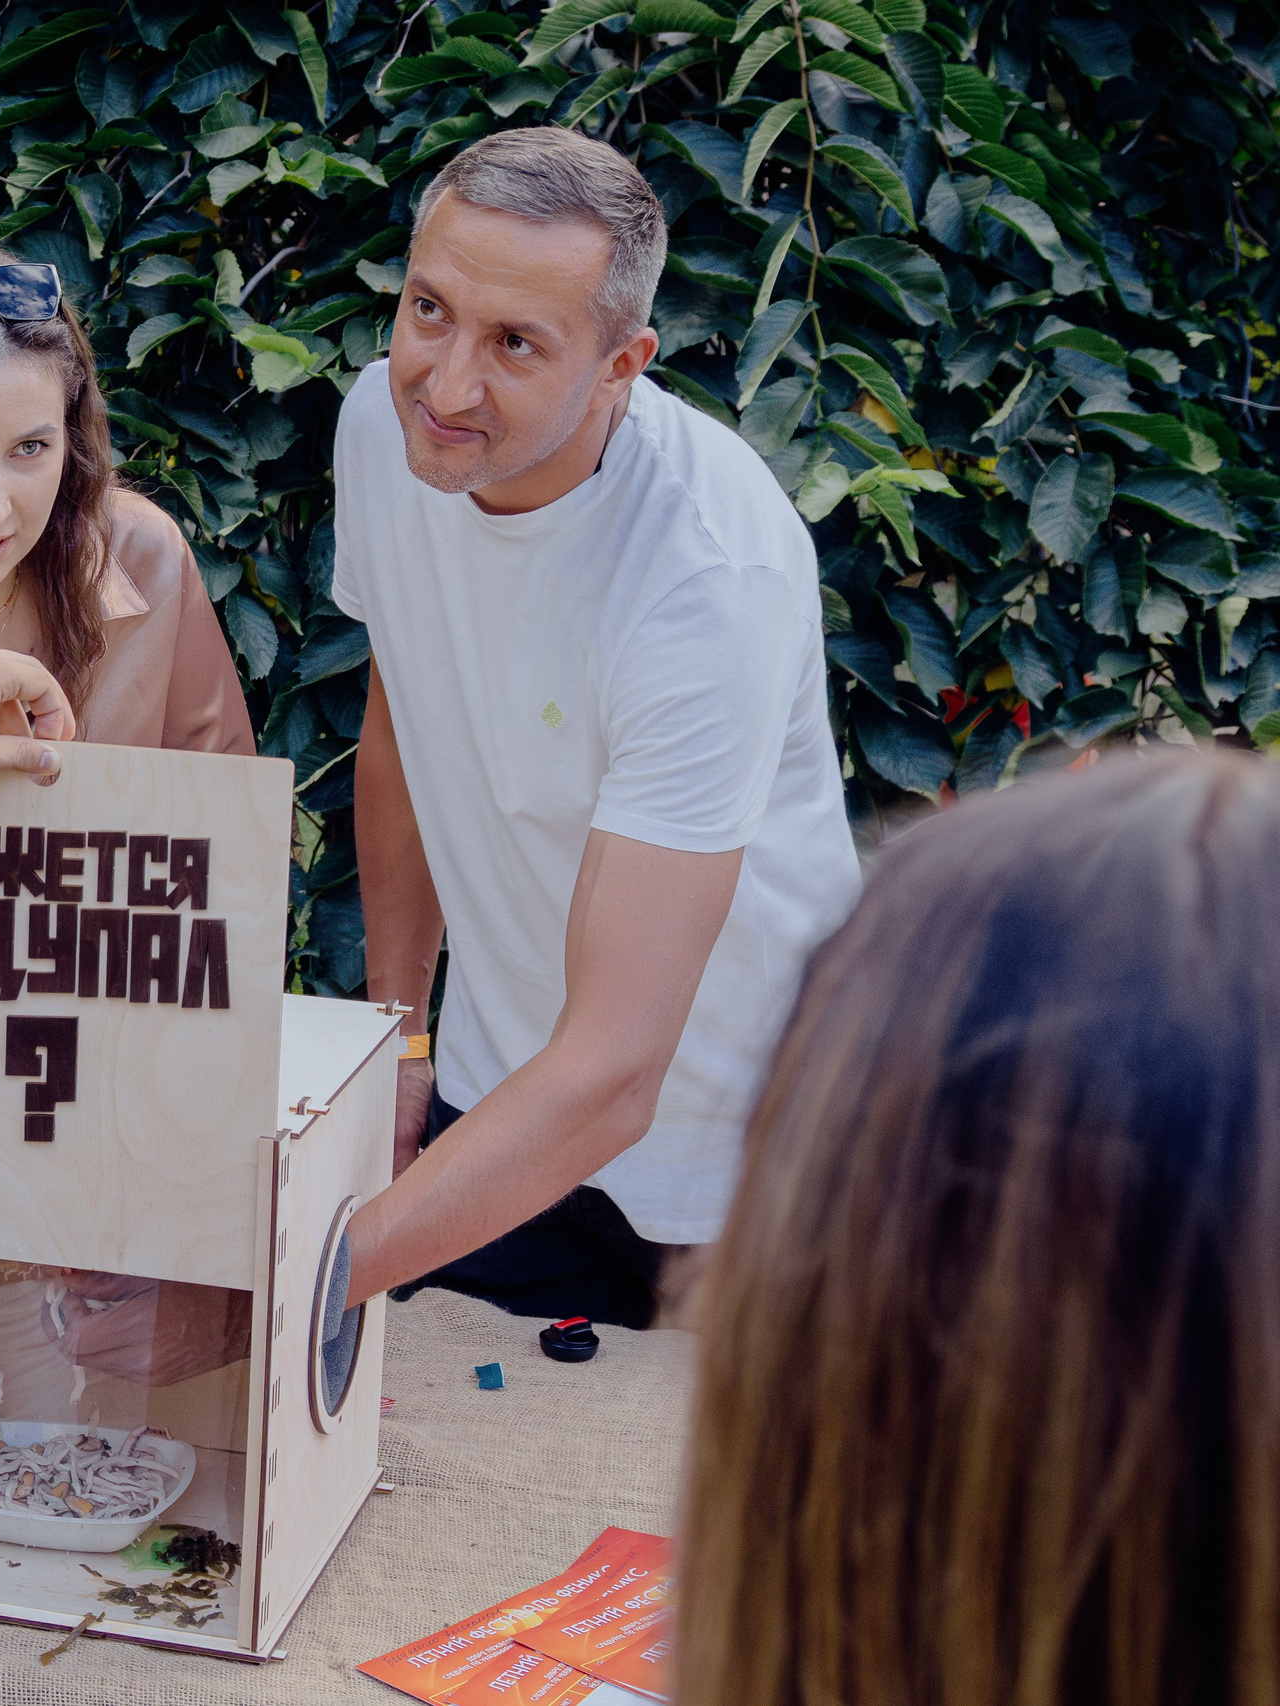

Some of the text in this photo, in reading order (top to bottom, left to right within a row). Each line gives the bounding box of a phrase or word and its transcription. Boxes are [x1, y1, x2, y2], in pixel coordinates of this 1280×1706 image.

[5, 1015, 79, 1142] ?
[407, 1636, 473, 1669] ЛЕТНИЙ
[469, 1597, 559, 1640] ФЕСТИВАЛЬ
[561, 1606, 628, 1639] ЛЕТНИЙ
[624, 1579, 674, 1609] ФЕСТИ
[488, 1653, 544, 1694] ЛЕТНИЙ
